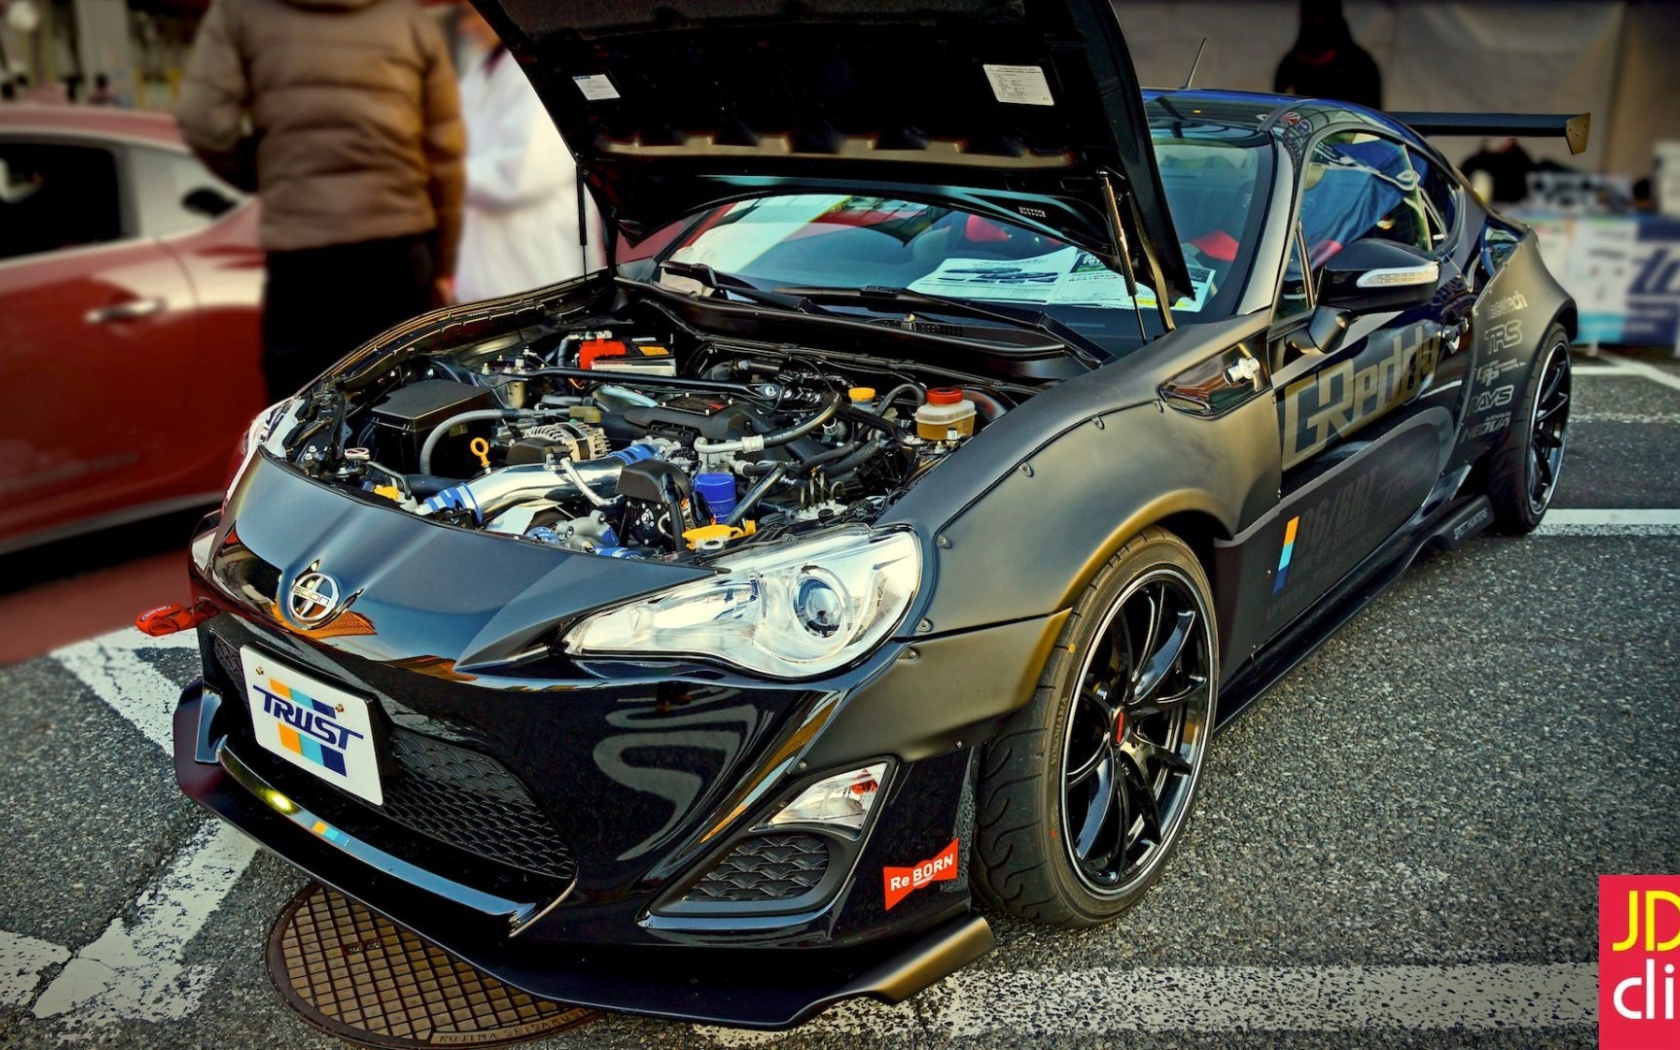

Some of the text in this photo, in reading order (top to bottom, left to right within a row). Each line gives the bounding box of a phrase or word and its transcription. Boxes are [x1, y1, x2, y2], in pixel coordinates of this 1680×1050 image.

[1467, 384, 1515, 417] RAYS
[253, 684, 364, 751] TRUST
[890, 853, 954, 892] Re BORN
